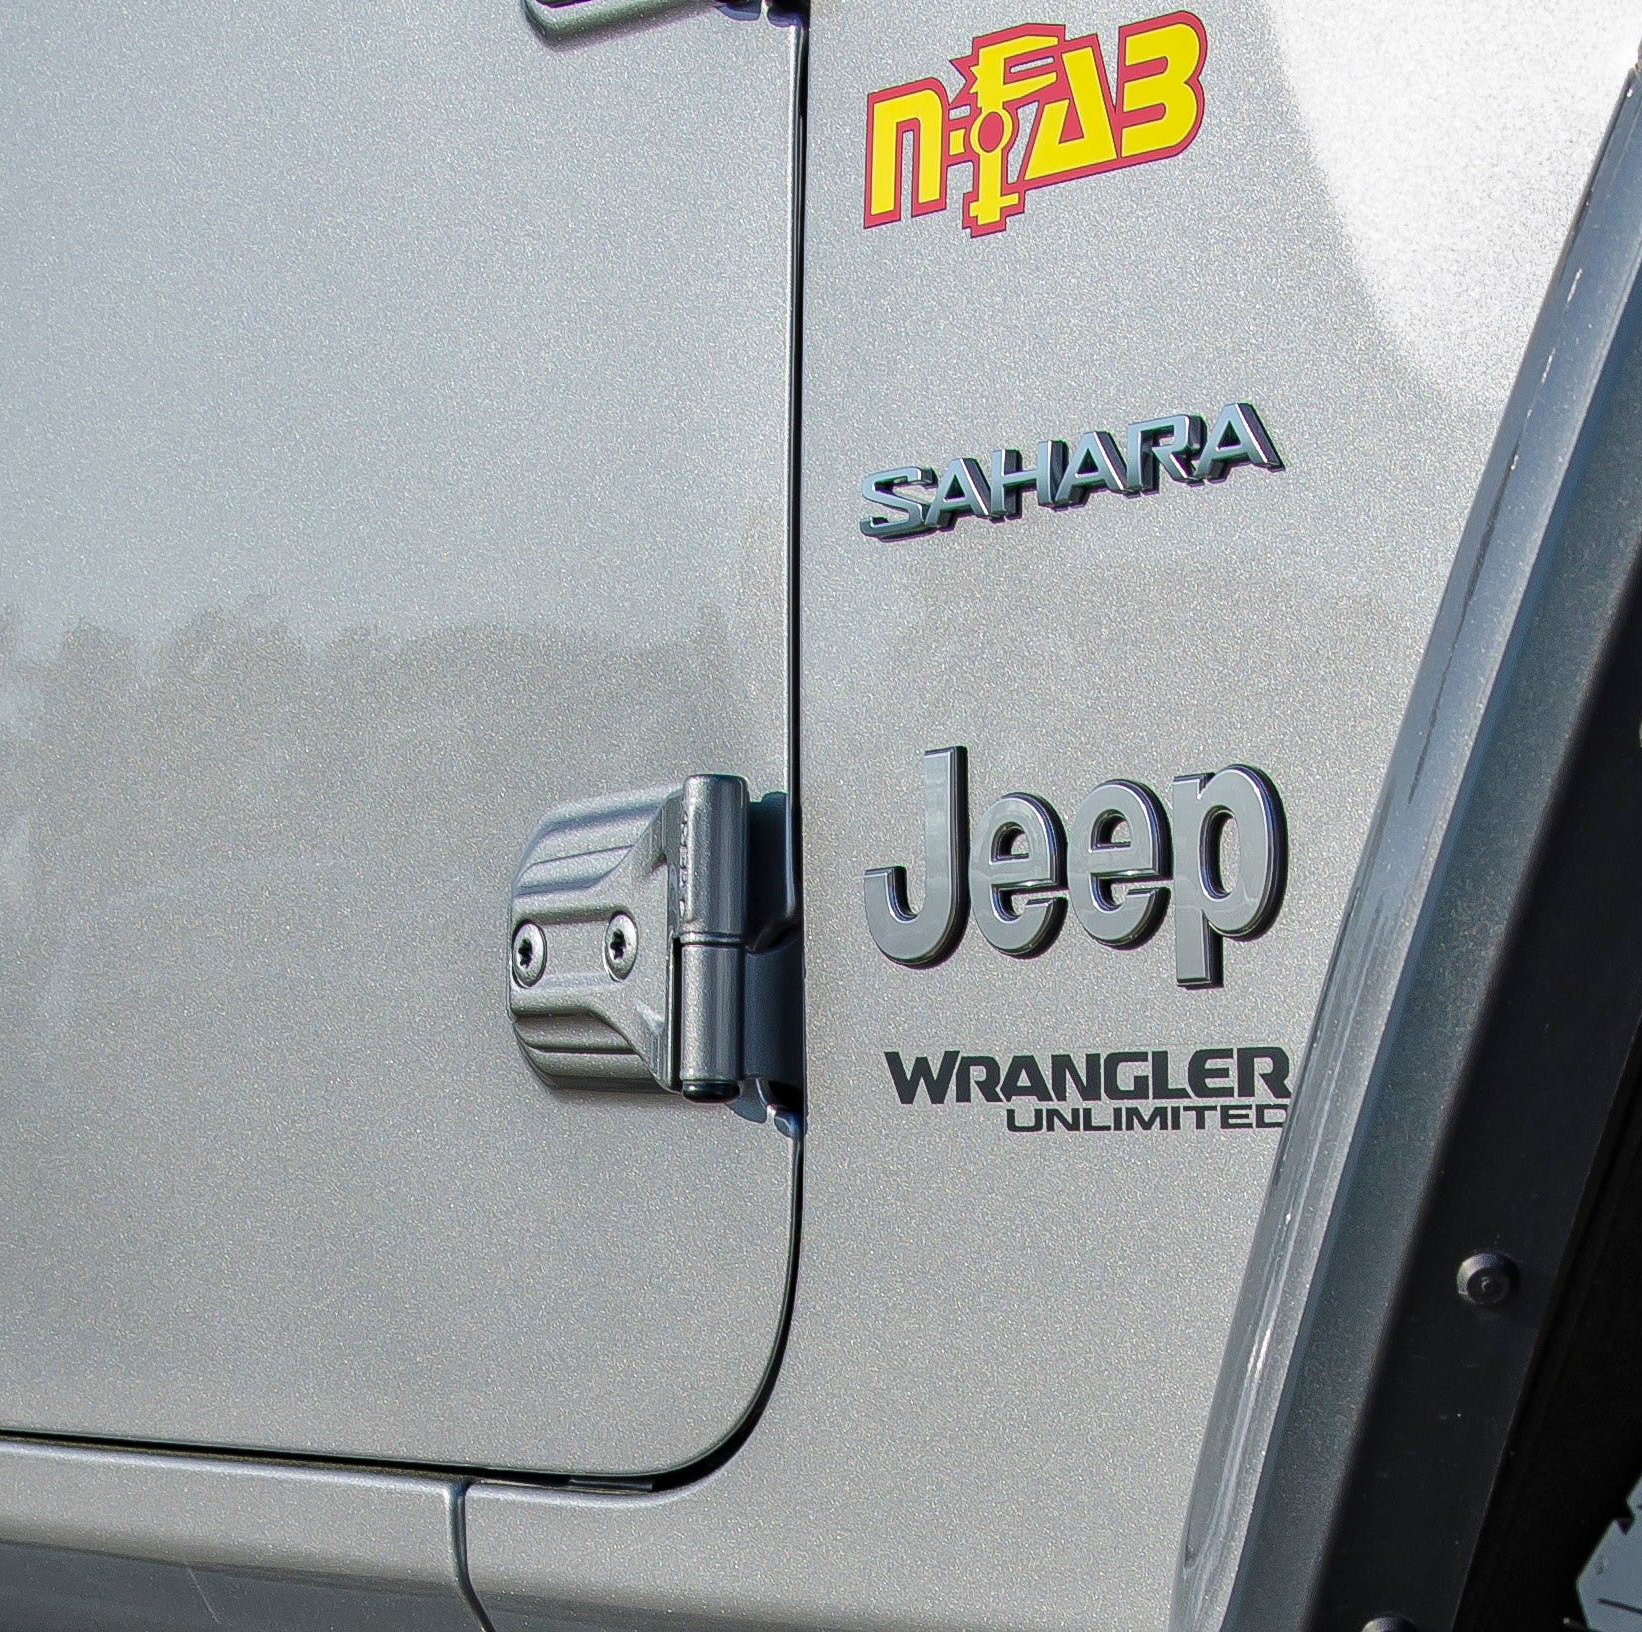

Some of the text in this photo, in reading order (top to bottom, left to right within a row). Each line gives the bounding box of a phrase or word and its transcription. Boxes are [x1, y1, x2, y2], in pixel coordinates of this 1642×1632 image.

[860, 402, 1285, 541] SAHARA
[864, 746, 1289, 990] Jeep
[884, 1046, 1291, 1104] WRANGLER
[1006, 1103, 1290, 1133] UNLIMITED
